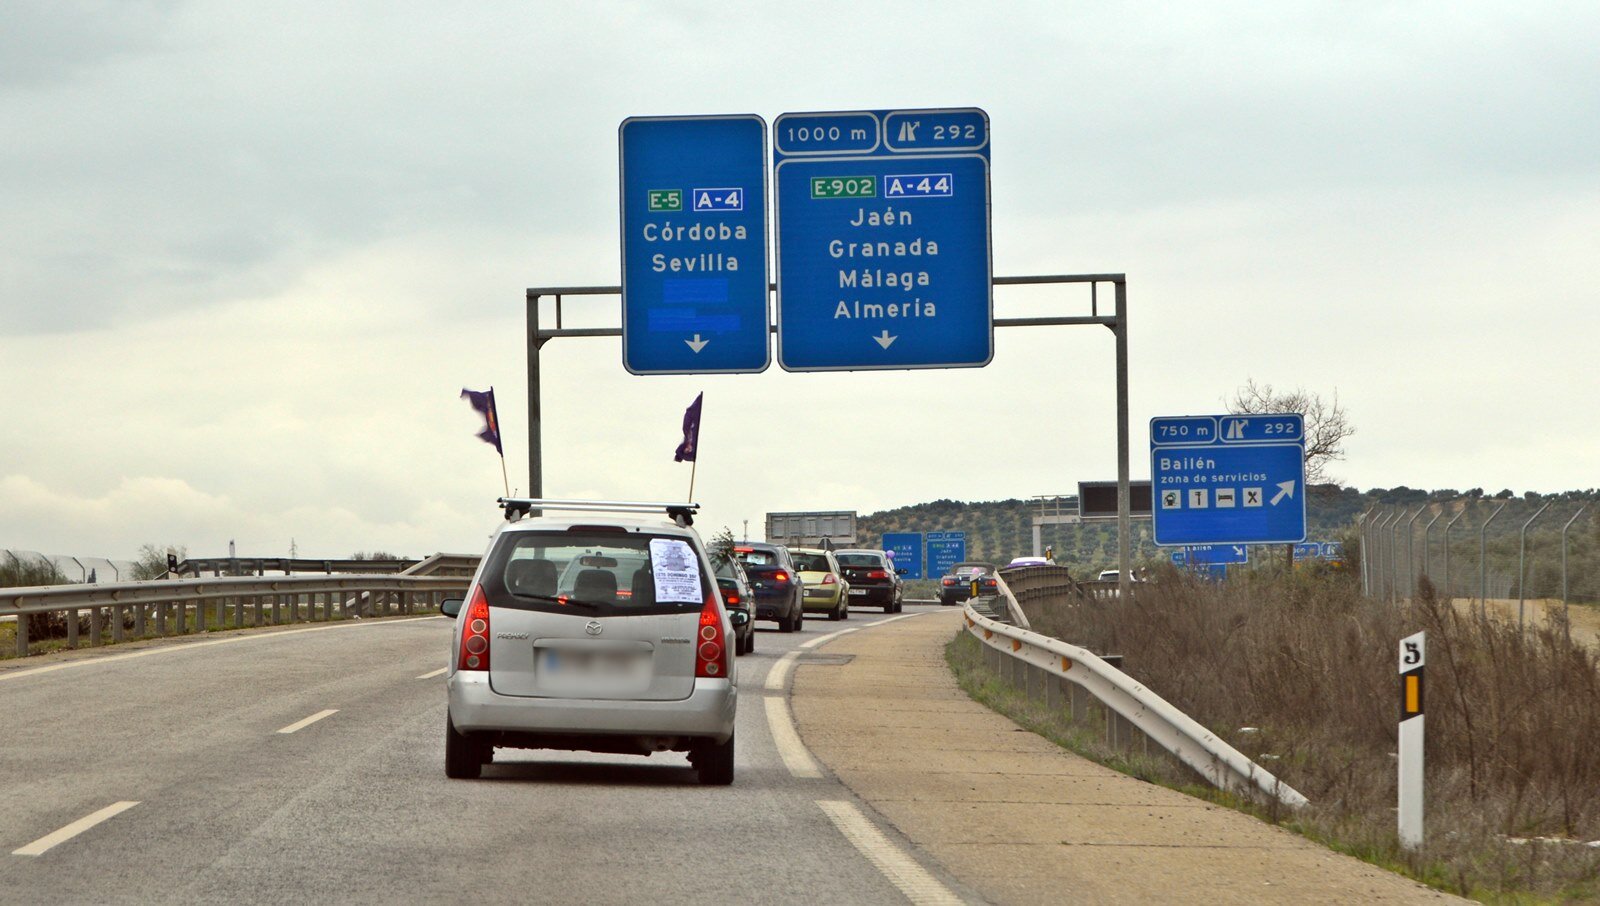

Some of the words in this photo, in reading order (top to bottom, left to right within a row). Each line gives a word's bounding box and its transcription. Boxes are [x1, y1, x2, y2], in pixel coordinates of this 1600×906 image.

[788, 126, 841, 142] 1000
[850, 128, 867, 141] m
[933, 124, 976, 140] 292
[889, 177, 949, 195] A-44
[650, 192, 680, 209] E-5
[697, 191, 740, 208] A-4
[850, 206, 912, 227] Jaén
[643, 221, 747, 242] Córdoba
[829, 237, 939, 259] Granada
[652, 253, 738, 273] Sevilla
[839, 268, 930, 292] Málaga
[833, 297, 936, 319] Almería
[1159, 425, 1189, 437] 750
[1196, 427, 1209, 436] m
[1264, 422, 1294, 434] 292
[1160, 456, 1215, 471] Bailén
[1160, 475, 1190, 484] zona
[1193, 473, 1207, 483] de
[1211, 472, 1267, 483] servicios
[1403, 642, 1421, 665] 5
